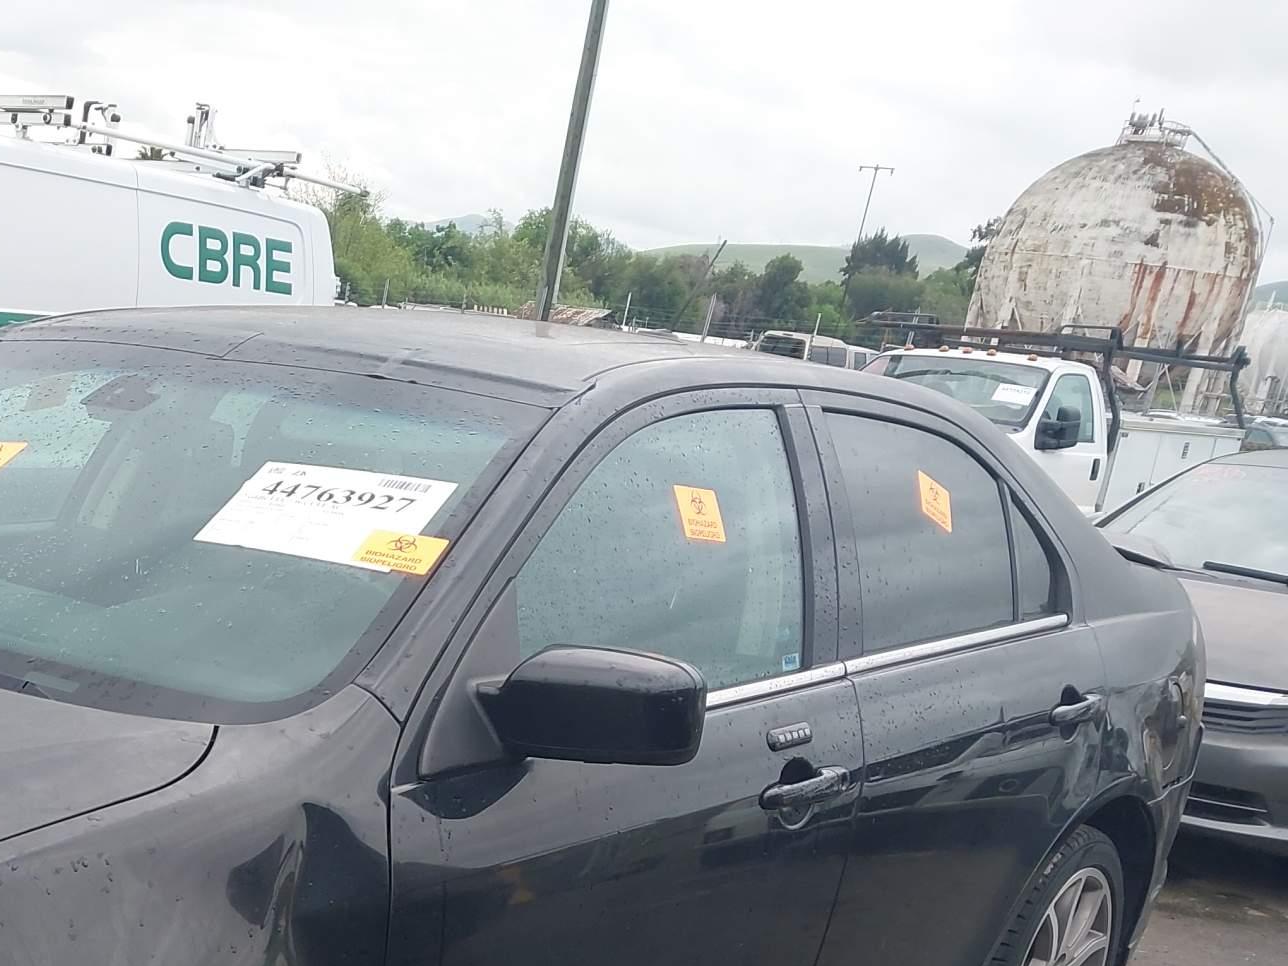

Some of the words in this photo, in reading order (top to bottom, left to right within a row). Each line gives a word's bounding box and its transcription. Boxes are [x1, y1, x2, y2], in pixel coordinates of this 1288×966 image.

[160, 221, 293, 296] CBRE
[261, 480, 419, 513] 44763927
[360, 556, 417, 571] BIOPELIGRO
[365, 549, 423, 565] BIOHAZARD
